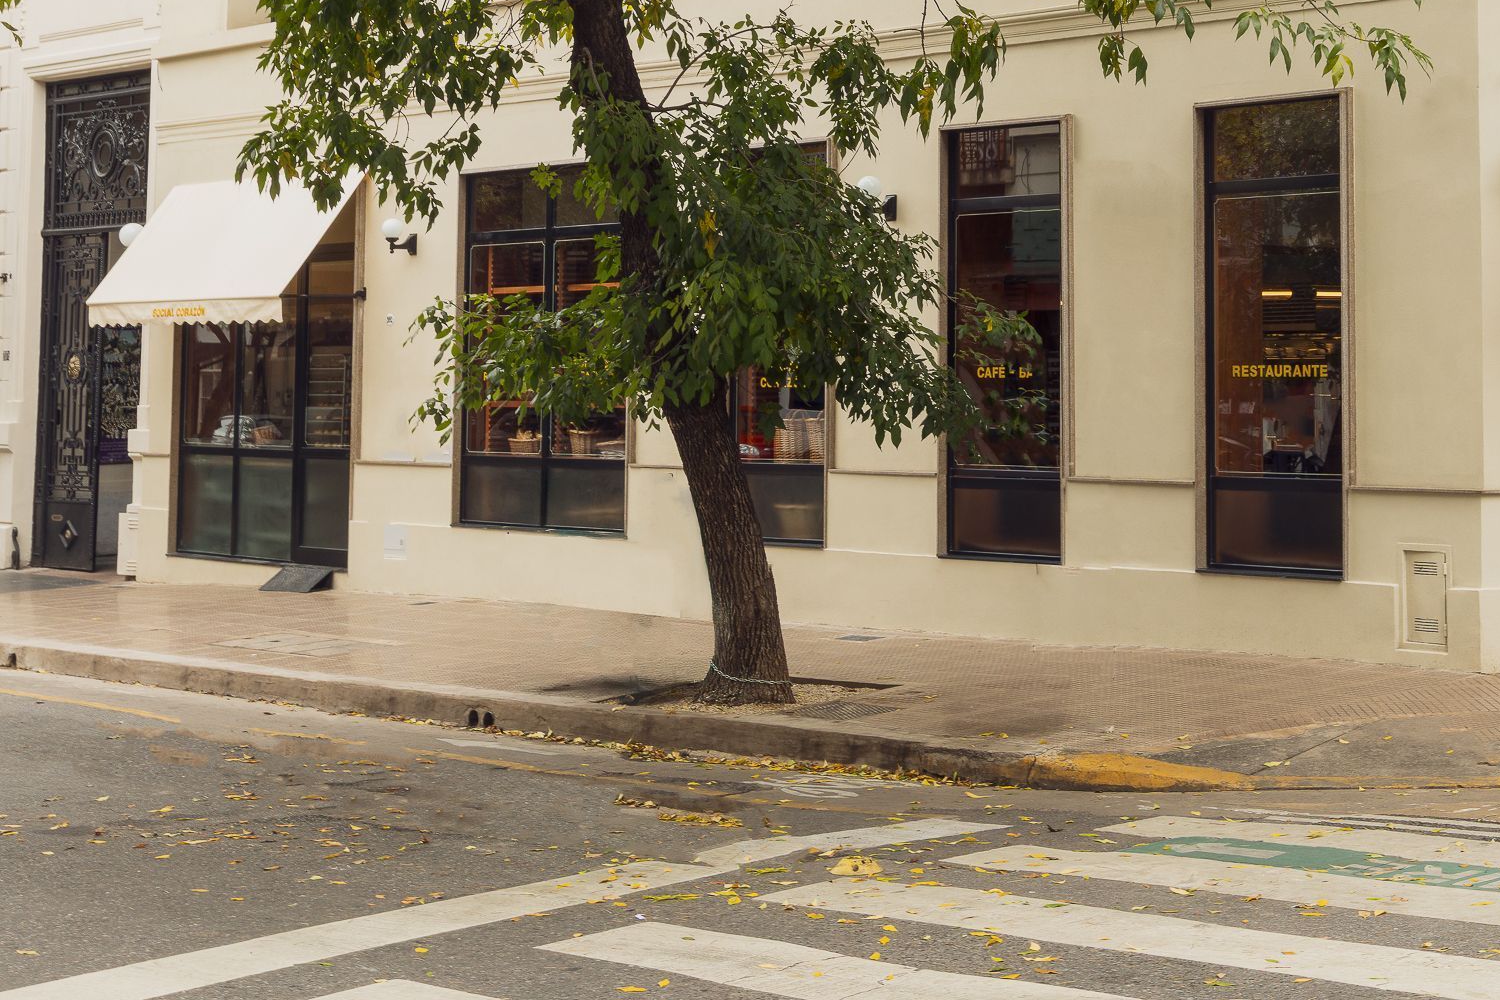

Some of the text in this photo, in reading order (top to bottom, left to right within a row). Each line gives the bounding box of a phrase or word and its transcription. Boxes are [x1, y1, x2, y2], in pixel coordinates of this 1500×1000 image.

[152, 306, 205, 317] SOCIAL CORAZÓN
[977, 364, 1006, 378] CAFÉ
[1232, 364, 1328, 378] RESTAURANTE
